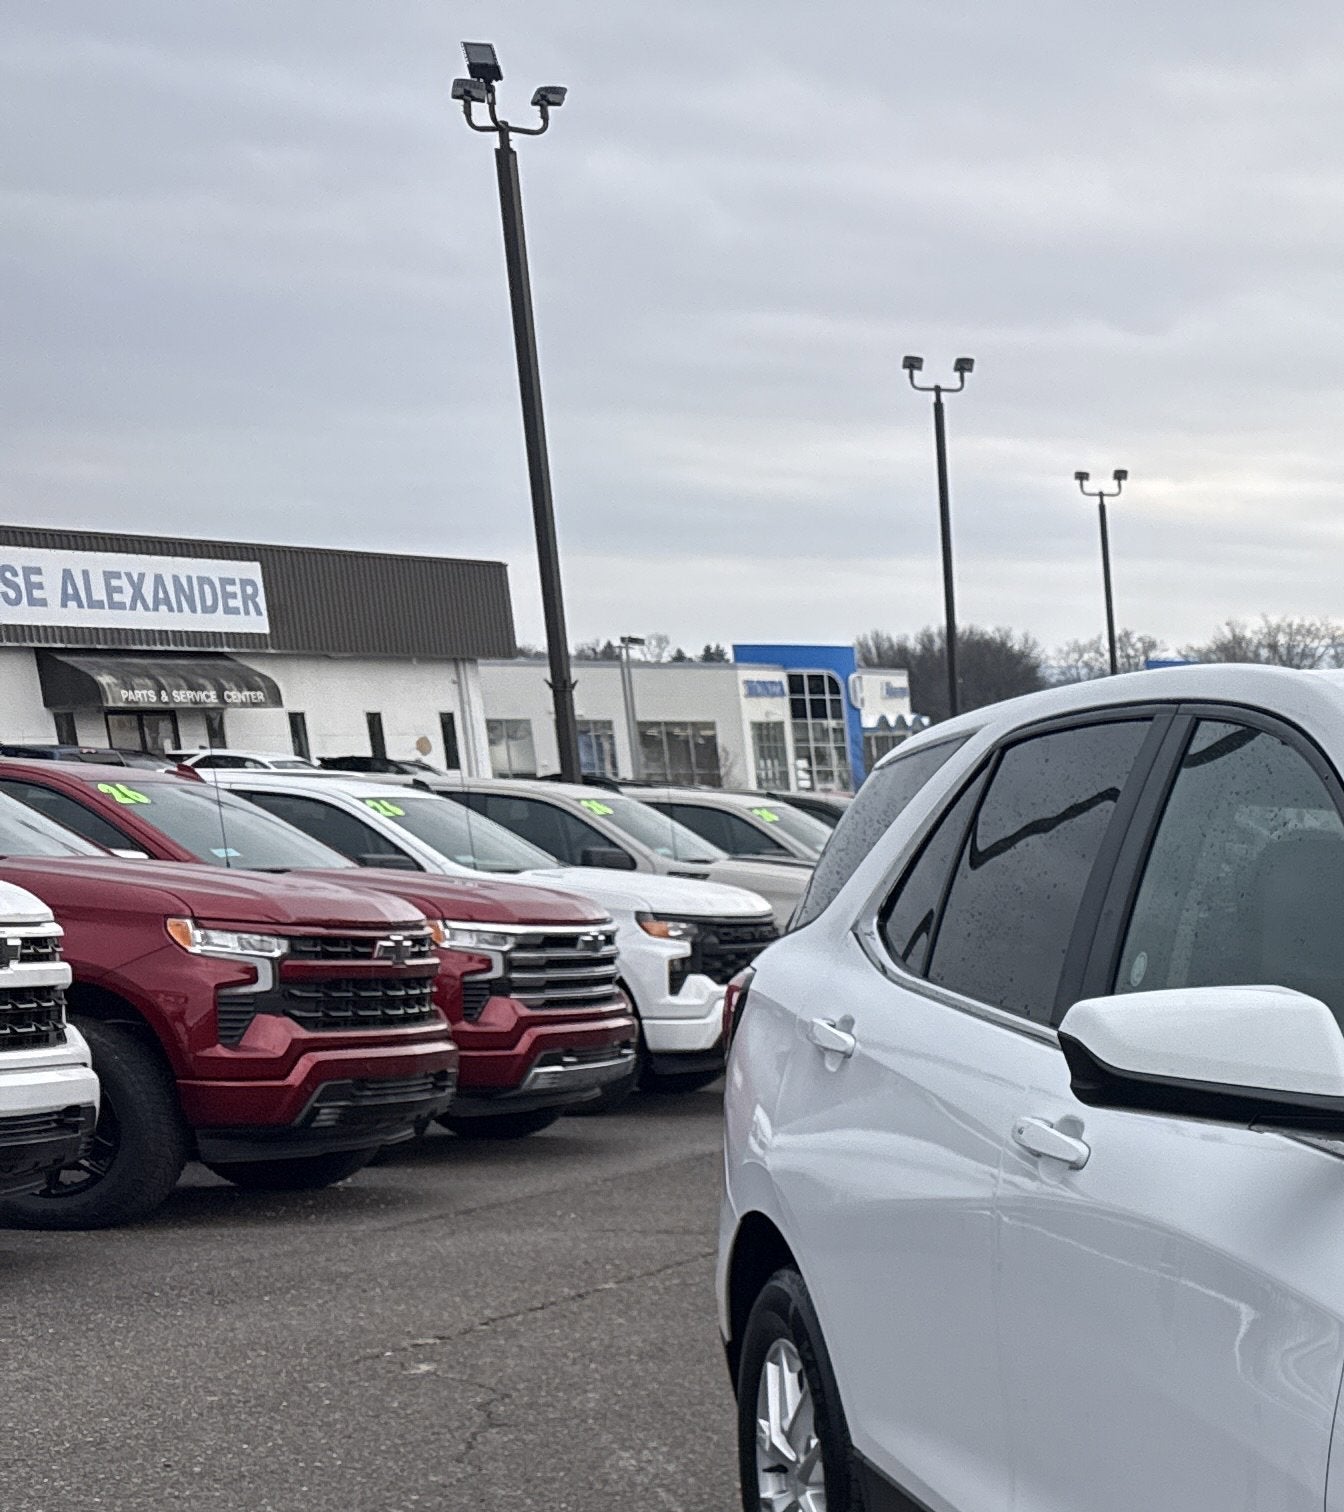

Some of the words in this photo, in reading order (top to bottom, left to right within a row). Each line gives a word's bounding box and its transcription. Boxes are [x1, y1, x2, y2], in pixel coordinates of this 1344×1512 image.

[60, 567, 263, 617] ALEXANDER
[120, 689, 157, 703] PARTS
[160, 690, 169, 702] &
[172, 690, 217, 703] SERVICE
[223, 690, 266, 703] CENTER
